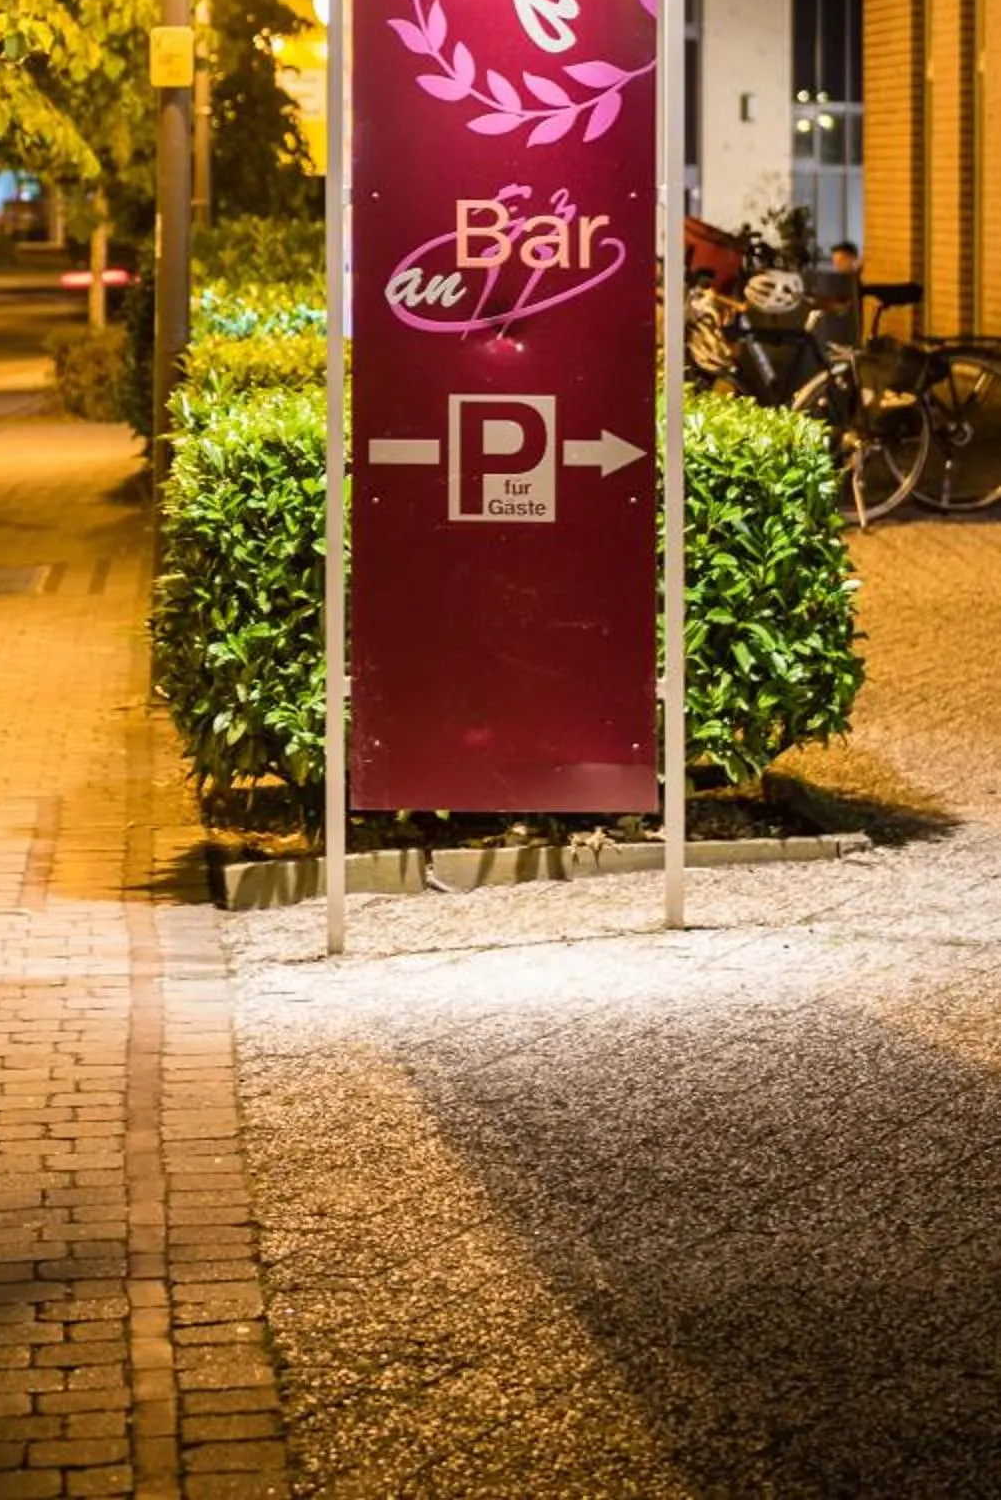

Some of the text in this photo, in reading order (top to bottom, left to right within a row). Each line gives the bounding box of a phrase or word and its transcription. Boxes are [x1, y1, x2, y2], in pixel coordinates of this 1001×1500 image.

[456, 199, 609, 269] Bar
[385, 266, 467, 308] an
[460, 401, 547, 515] P
[488, 499, 546, 516] Gäste
[504, 479, 532, 495] für
